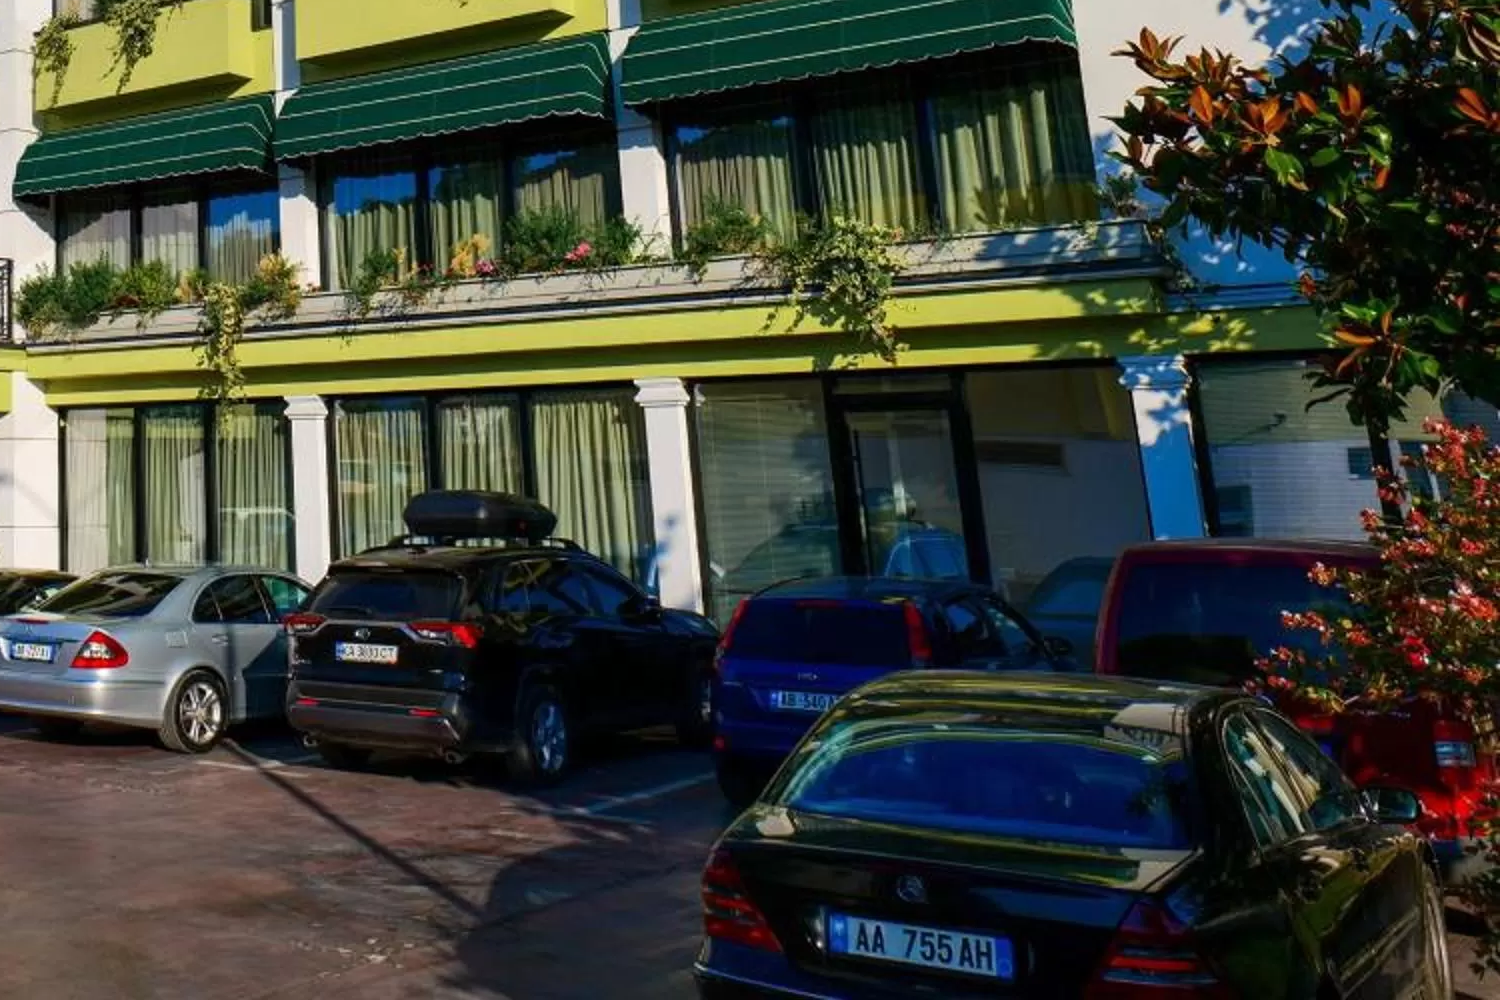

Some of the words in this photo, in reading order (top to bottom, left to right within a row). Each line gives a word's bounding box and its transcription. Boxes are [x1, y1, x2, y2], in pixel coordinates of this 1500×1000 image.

[855, 921, 887, 955] AA
[902, 928, 954, 964] 755
[958, 936, 994, 972] AH
